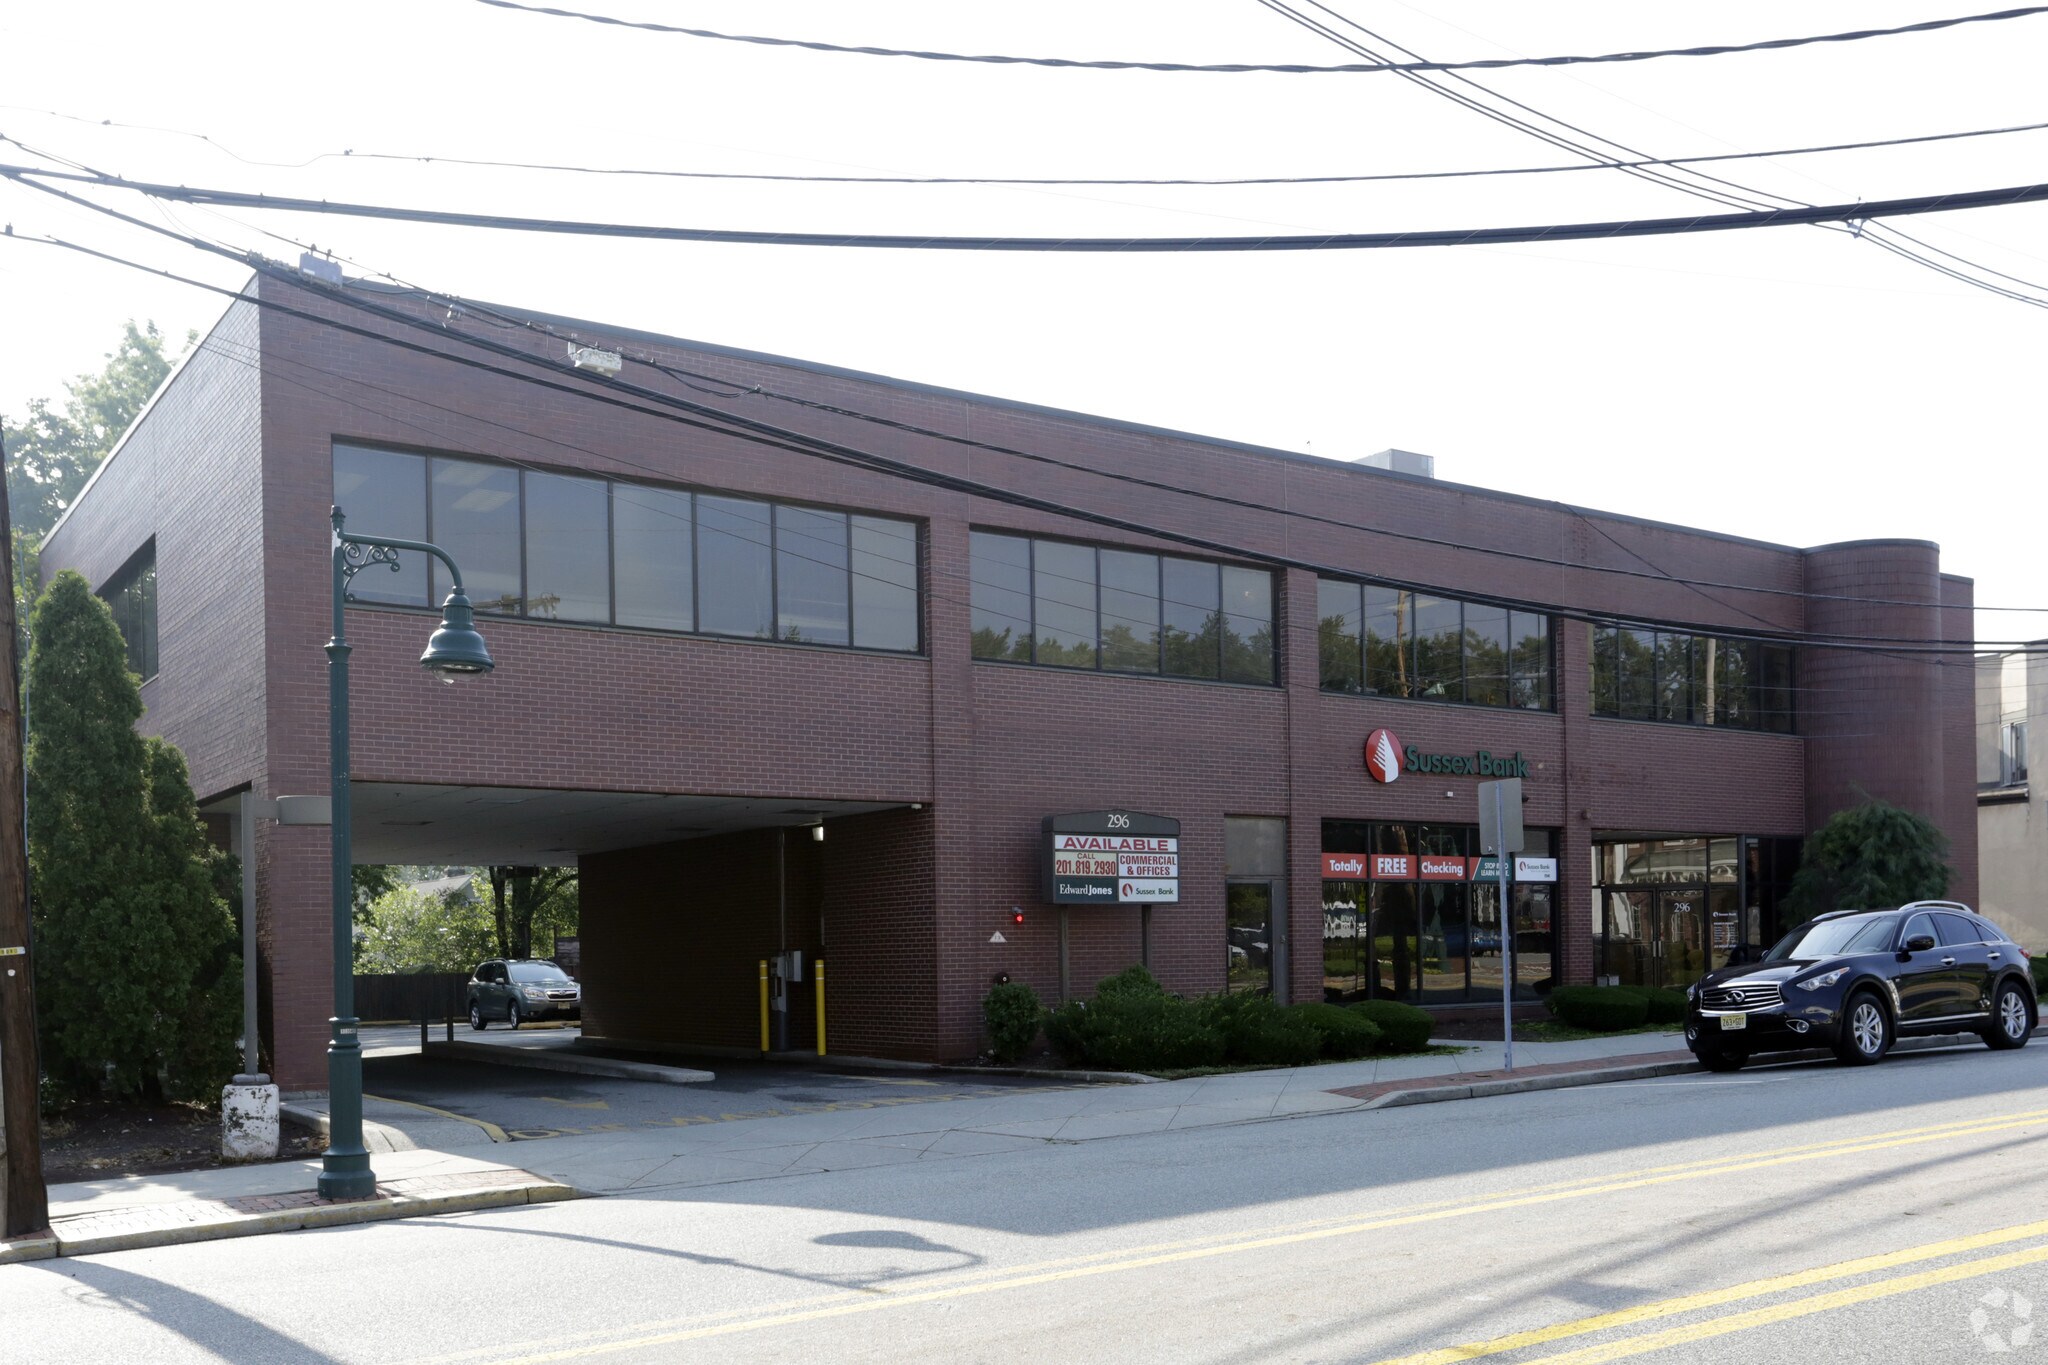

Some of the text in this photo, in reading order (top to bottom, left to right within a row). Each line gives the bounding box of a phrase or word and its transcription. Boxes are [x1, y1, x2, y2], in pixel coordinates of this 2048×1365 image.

[1406, 745, 1530, 778] Sussex Bank
[1107, 814, 1130, 828] 296
[1063, 837, 1169, 851] AVAILABLE
[1056, 860, 1116, 875] 201.819.2930
[1119, 855, 1177, 866] COMMERCIAL
[1329, 857, 1464, 877] Totally FREE Checking
[1127, 866, 1171, 876] & OFFICES
[1674, 902, 1691, 913] 296
